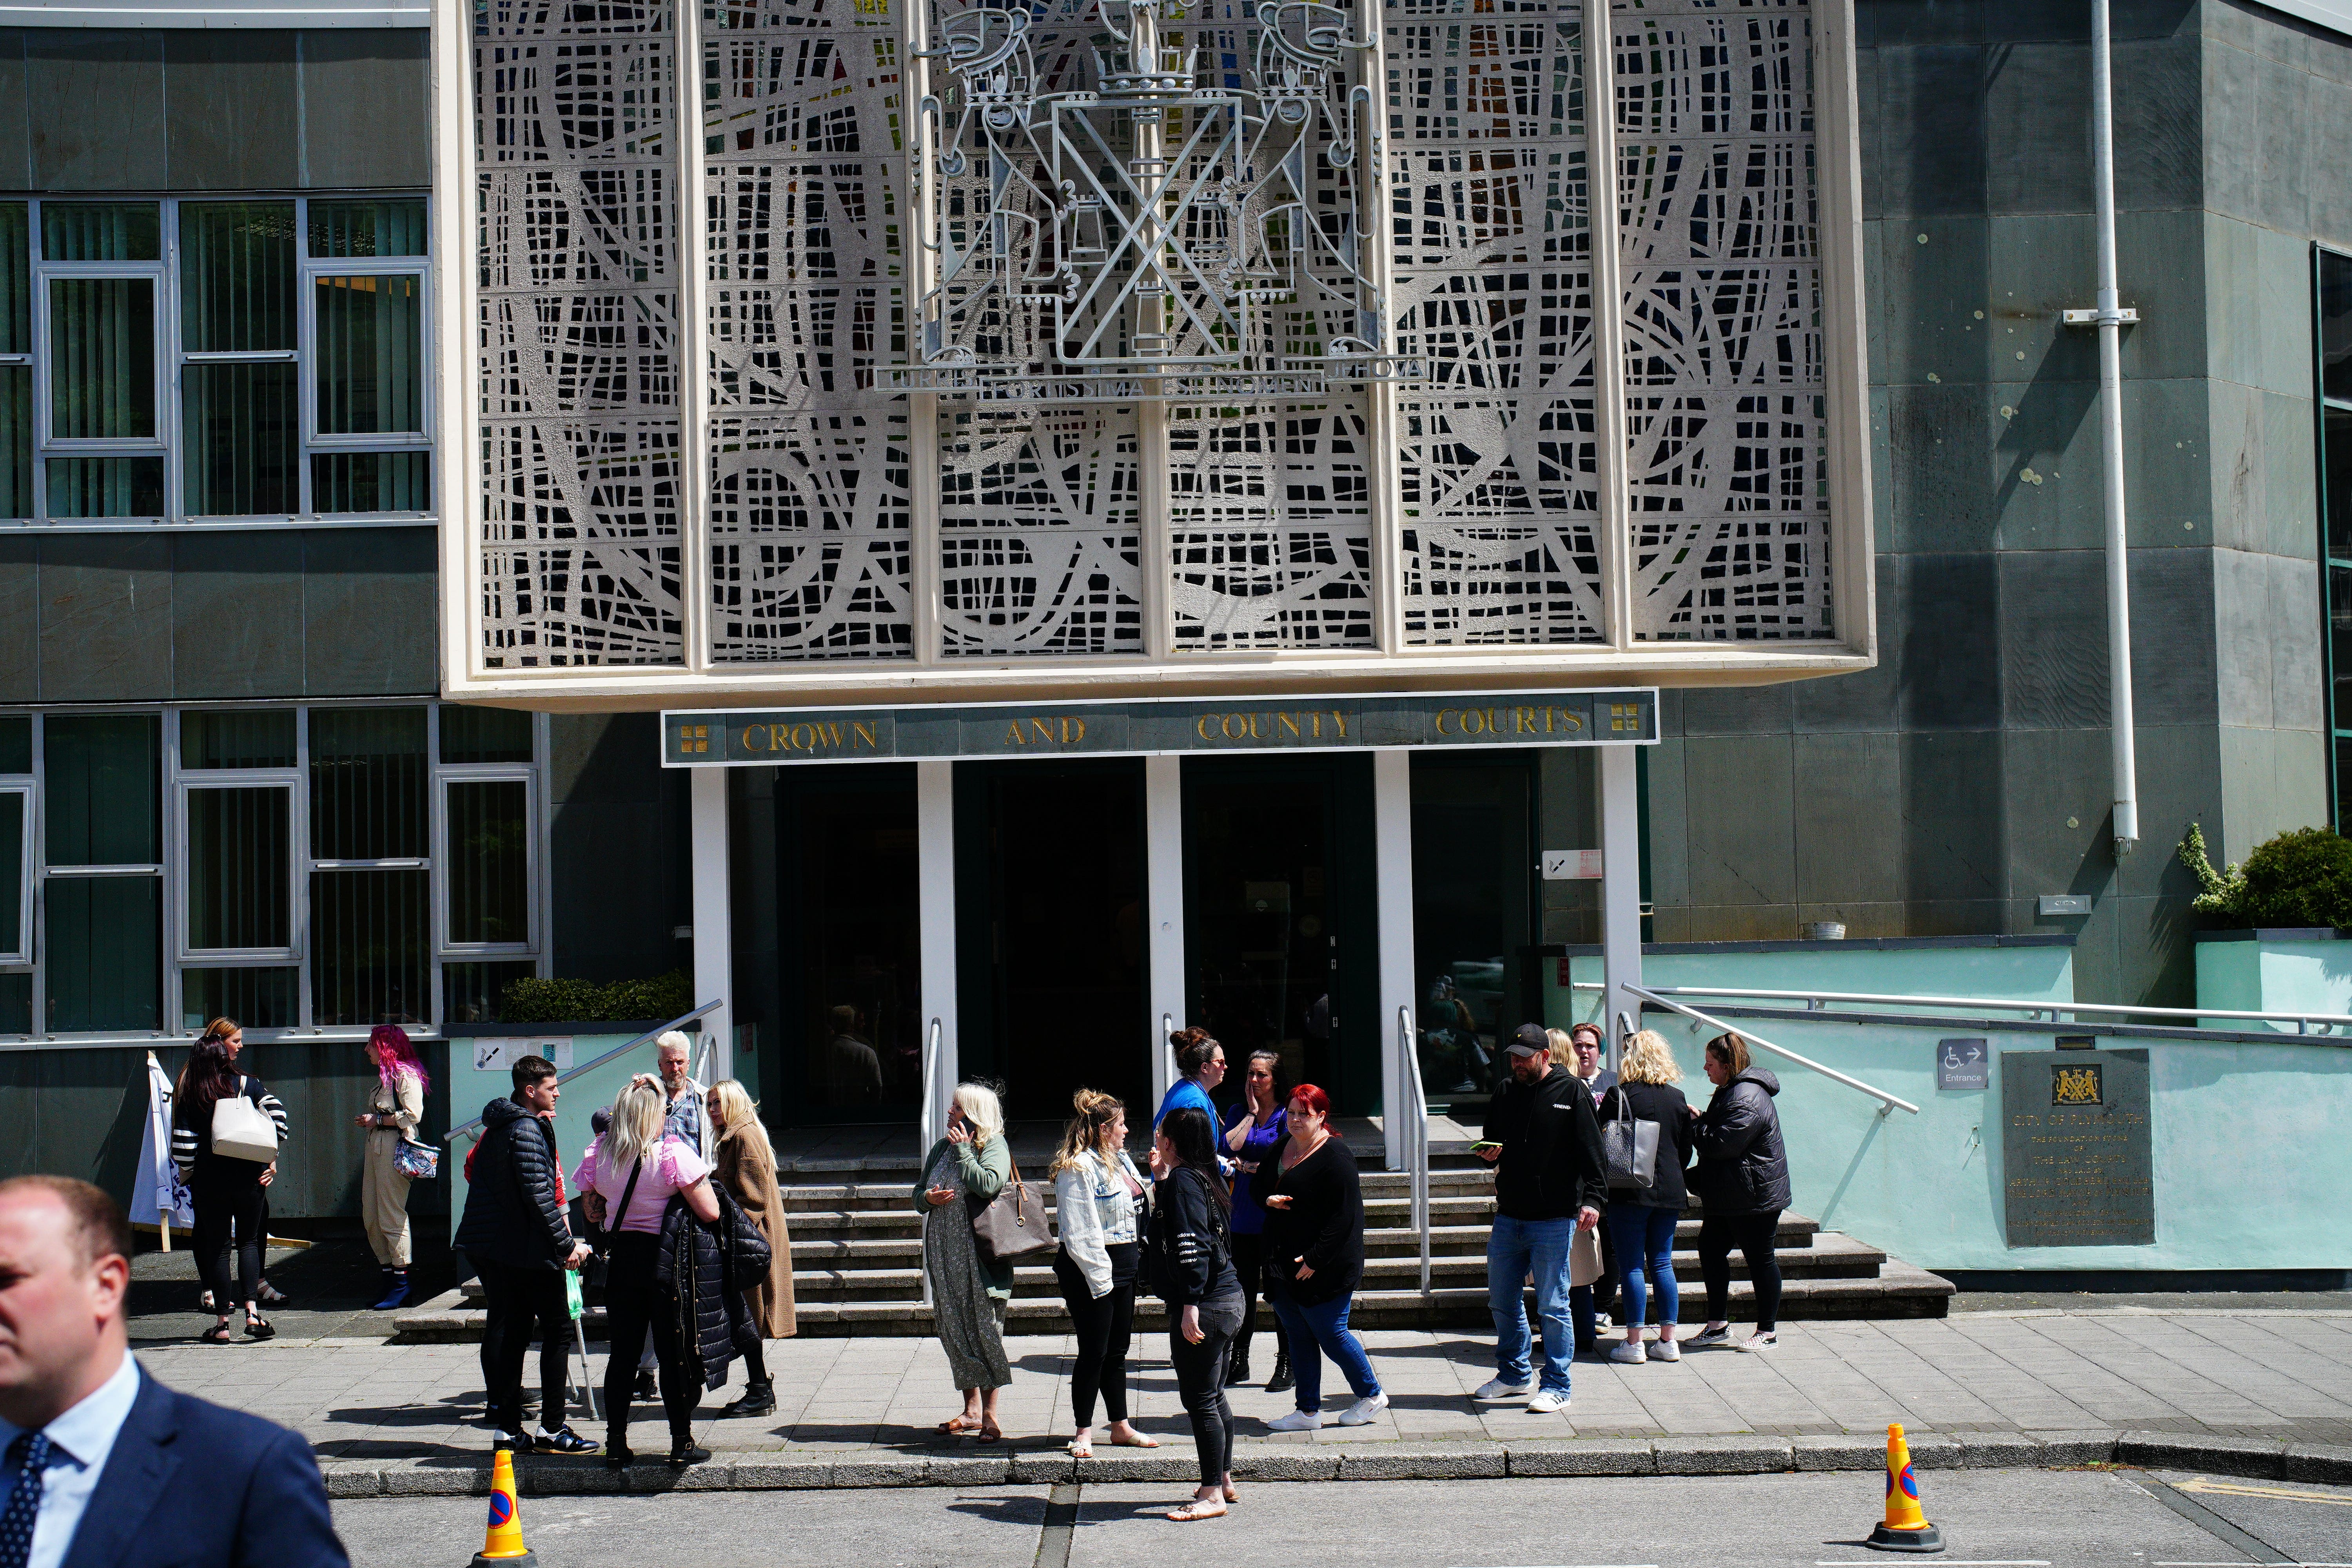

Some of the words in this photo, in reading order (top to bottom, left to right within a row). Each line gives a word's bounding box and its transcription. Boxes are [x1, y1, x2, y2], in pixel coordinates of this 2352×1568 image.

[1217, 376, 1311, 394] NOMEN
[1327, 359, 1423, 379] JEHOVA
[742, 721, 877, 752] CROWN
[1004, 716, 1087, 745] AND
[1198, 710, 1354, 740] COUNTY
[1435, 705, 1583, 735] COURTS
[2012, 1115, 2041, 1126] CITY
[2048, 1115, 2064, 1125] OF
[2071, 1114, 2143, 1125] PLYMOUTH
[2033, 1156, 2054, 1164] THE
[2058, 1156, 2080, 1164] LAW
[2084, 1155, 2125, 1163] COURTS
